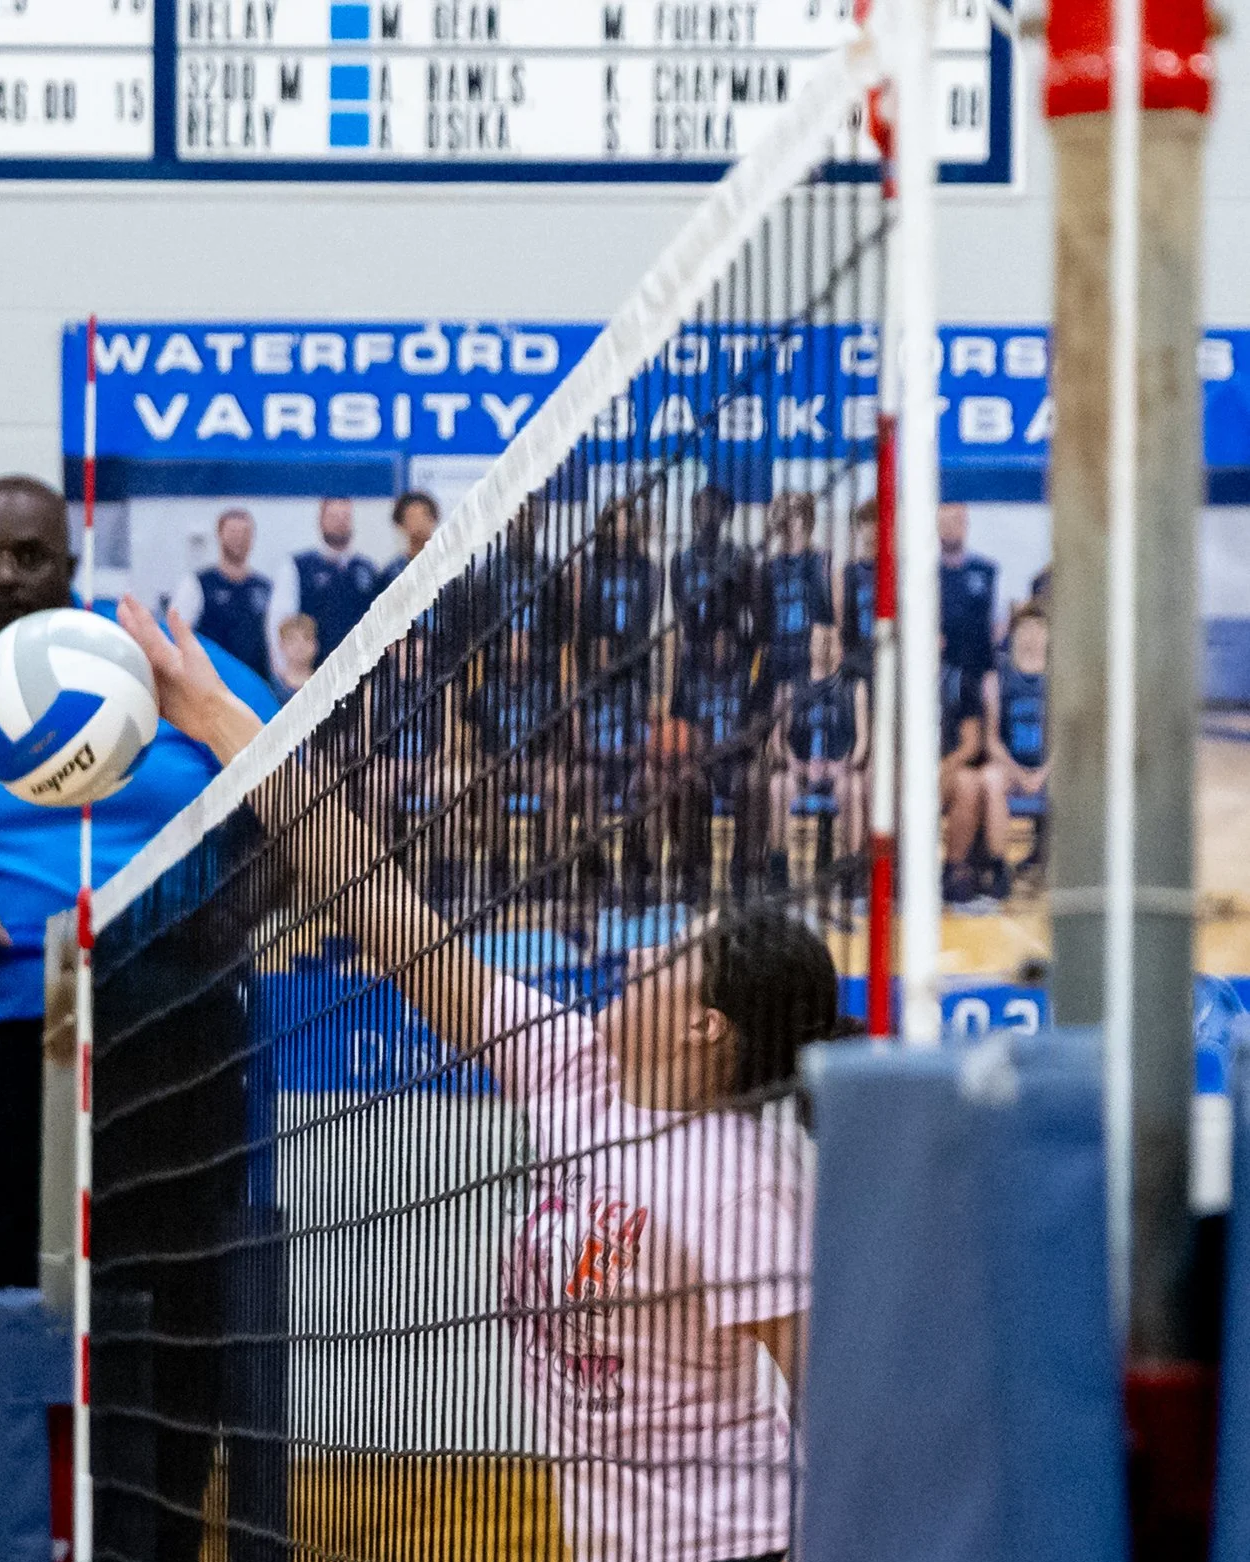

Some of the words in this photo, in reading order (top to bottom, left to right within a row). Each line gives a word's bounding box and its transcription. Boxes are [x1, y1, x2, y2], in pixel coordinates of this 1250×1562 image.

[278, 62, 302, 102] M
[93, 331, 561, 377] WATERFORD
[658, 333, 803, 378] OTT
[133, 392, 534, 442] VARSITY
